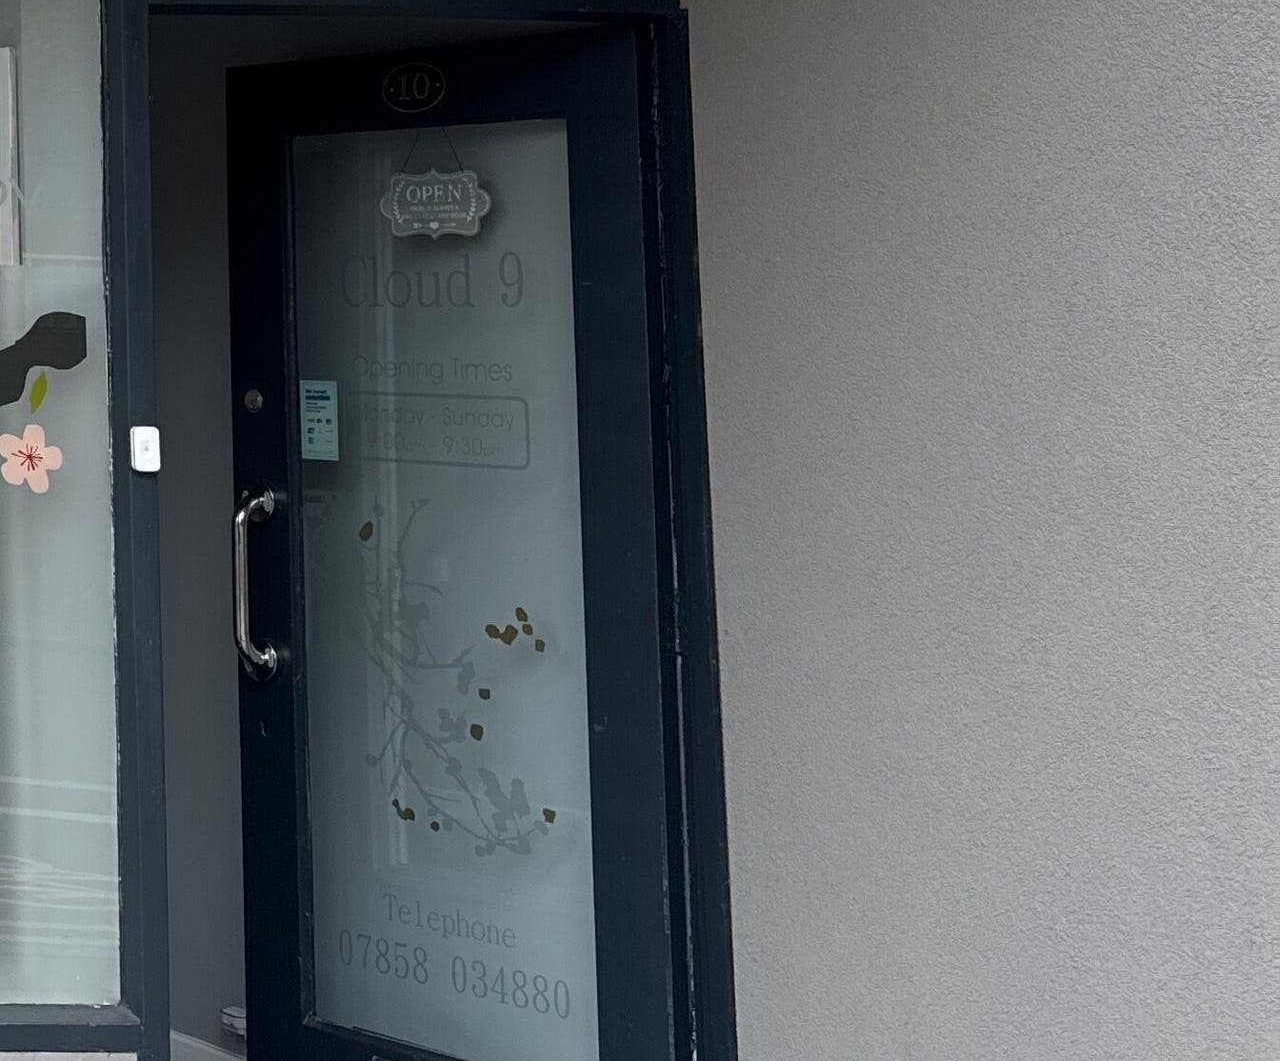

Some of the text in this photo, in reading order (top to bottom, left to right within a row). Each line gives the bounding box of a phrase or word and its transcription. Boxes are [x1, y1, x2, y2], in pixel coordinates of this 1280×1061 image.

[397, 72, 431, 101] 10
[405, 184, 464, 206] OPEN
[341, 250, 525, 309] Cloud 9
[451, 357, 513, 383] Times
[440, 403, 515, 433] Sunday
[383, 893, 517, 949] Telephone
[339, 929, 571, 1020] 07858 034880
